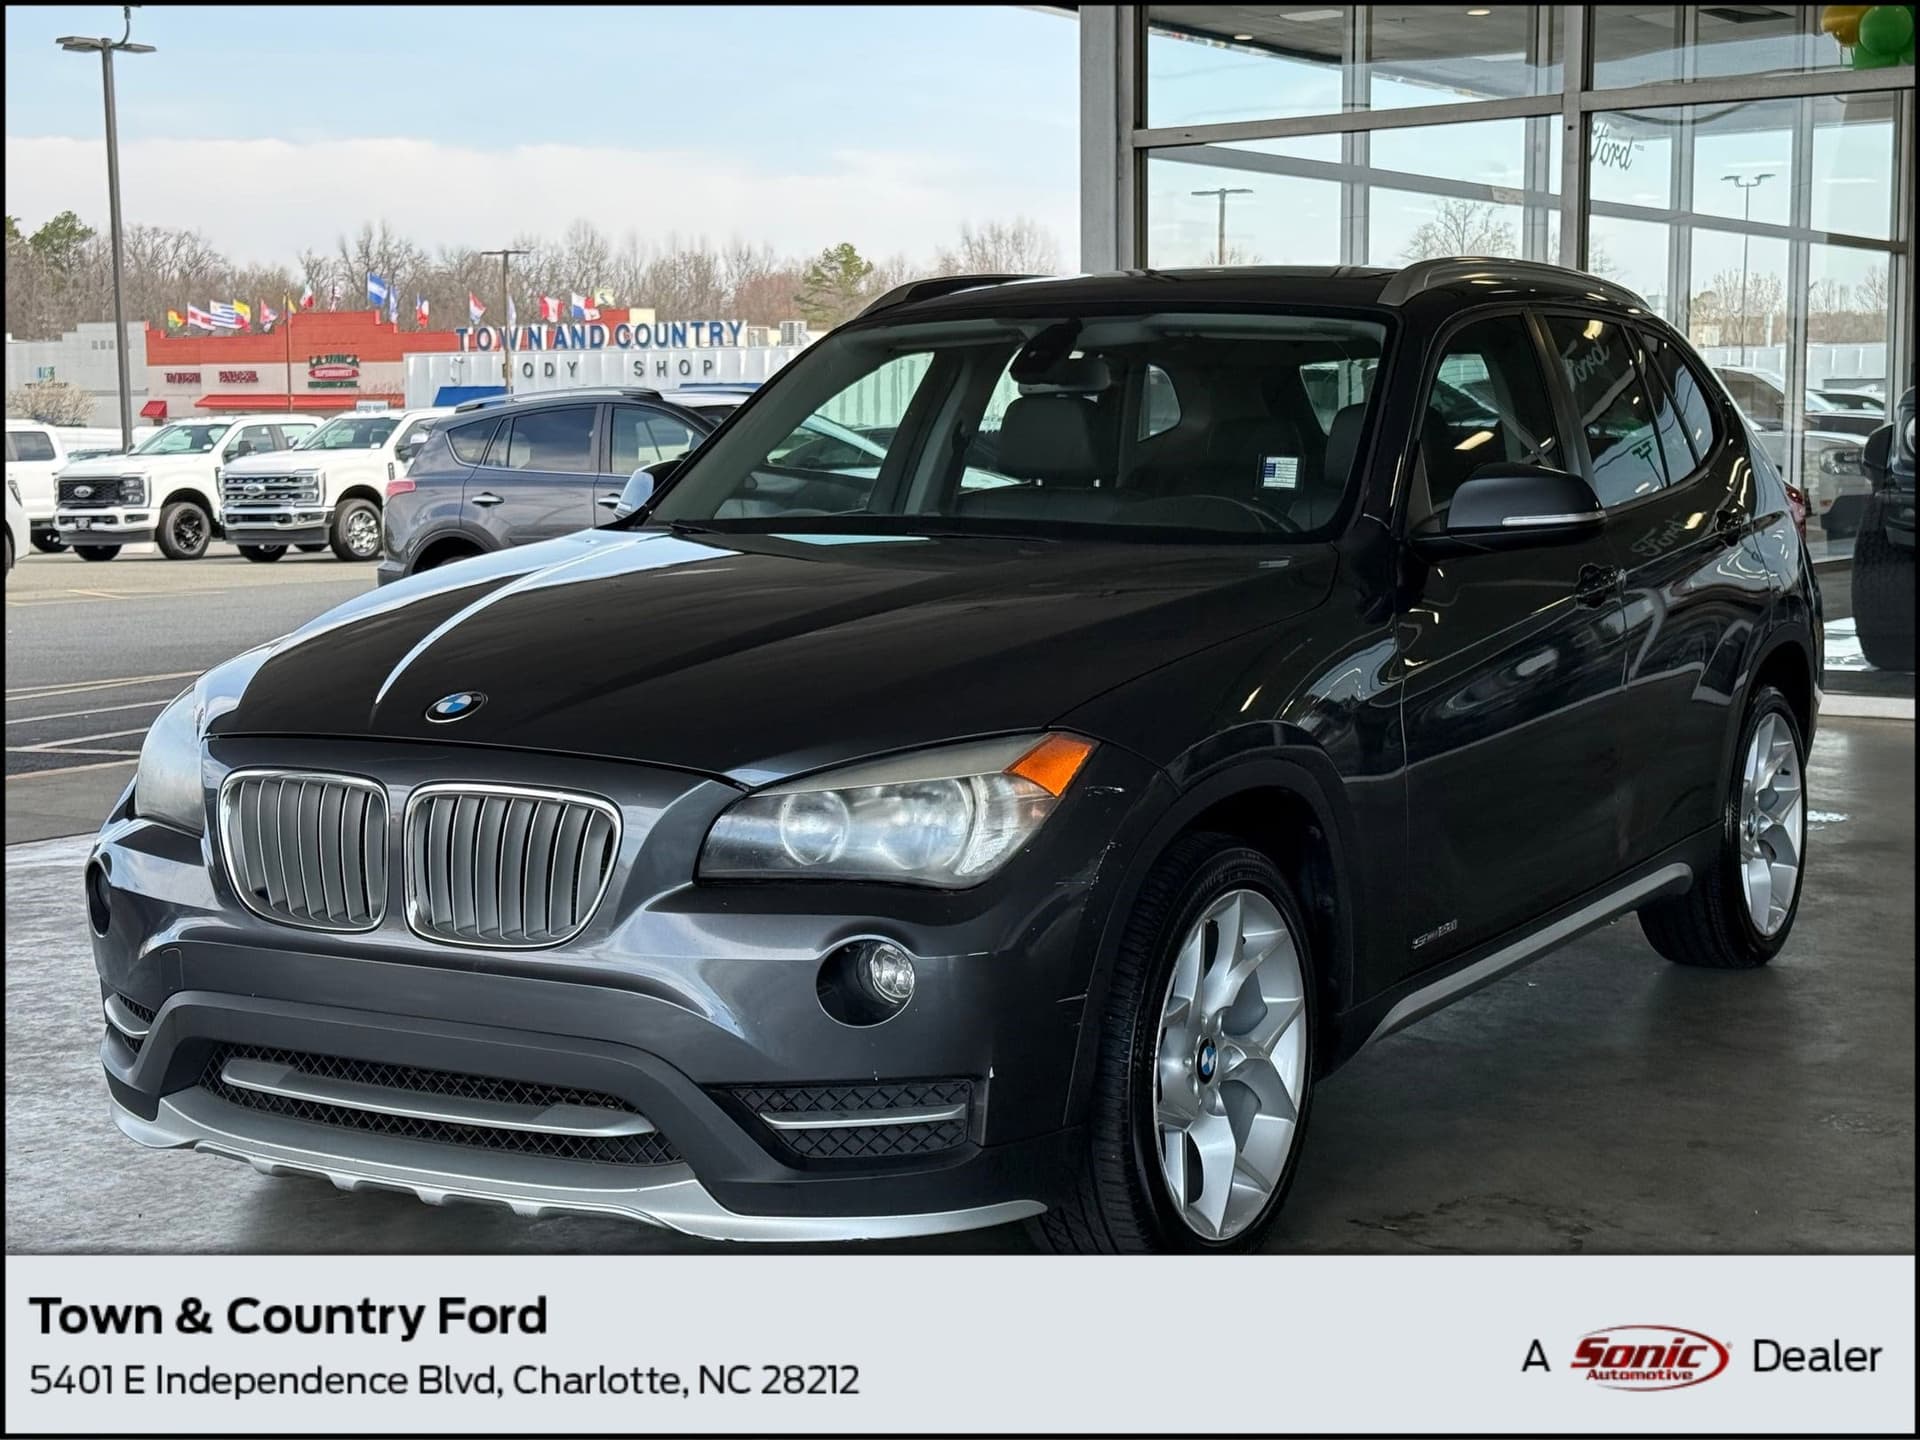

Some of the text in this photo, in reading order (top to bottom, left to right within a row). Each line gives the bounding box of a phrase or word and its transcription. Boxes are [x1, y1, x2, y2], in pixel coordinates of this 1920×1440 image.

[456, 321, 743, 351] TOWN AND COUNTRY
[633, 359, 714, 377] SHOP
